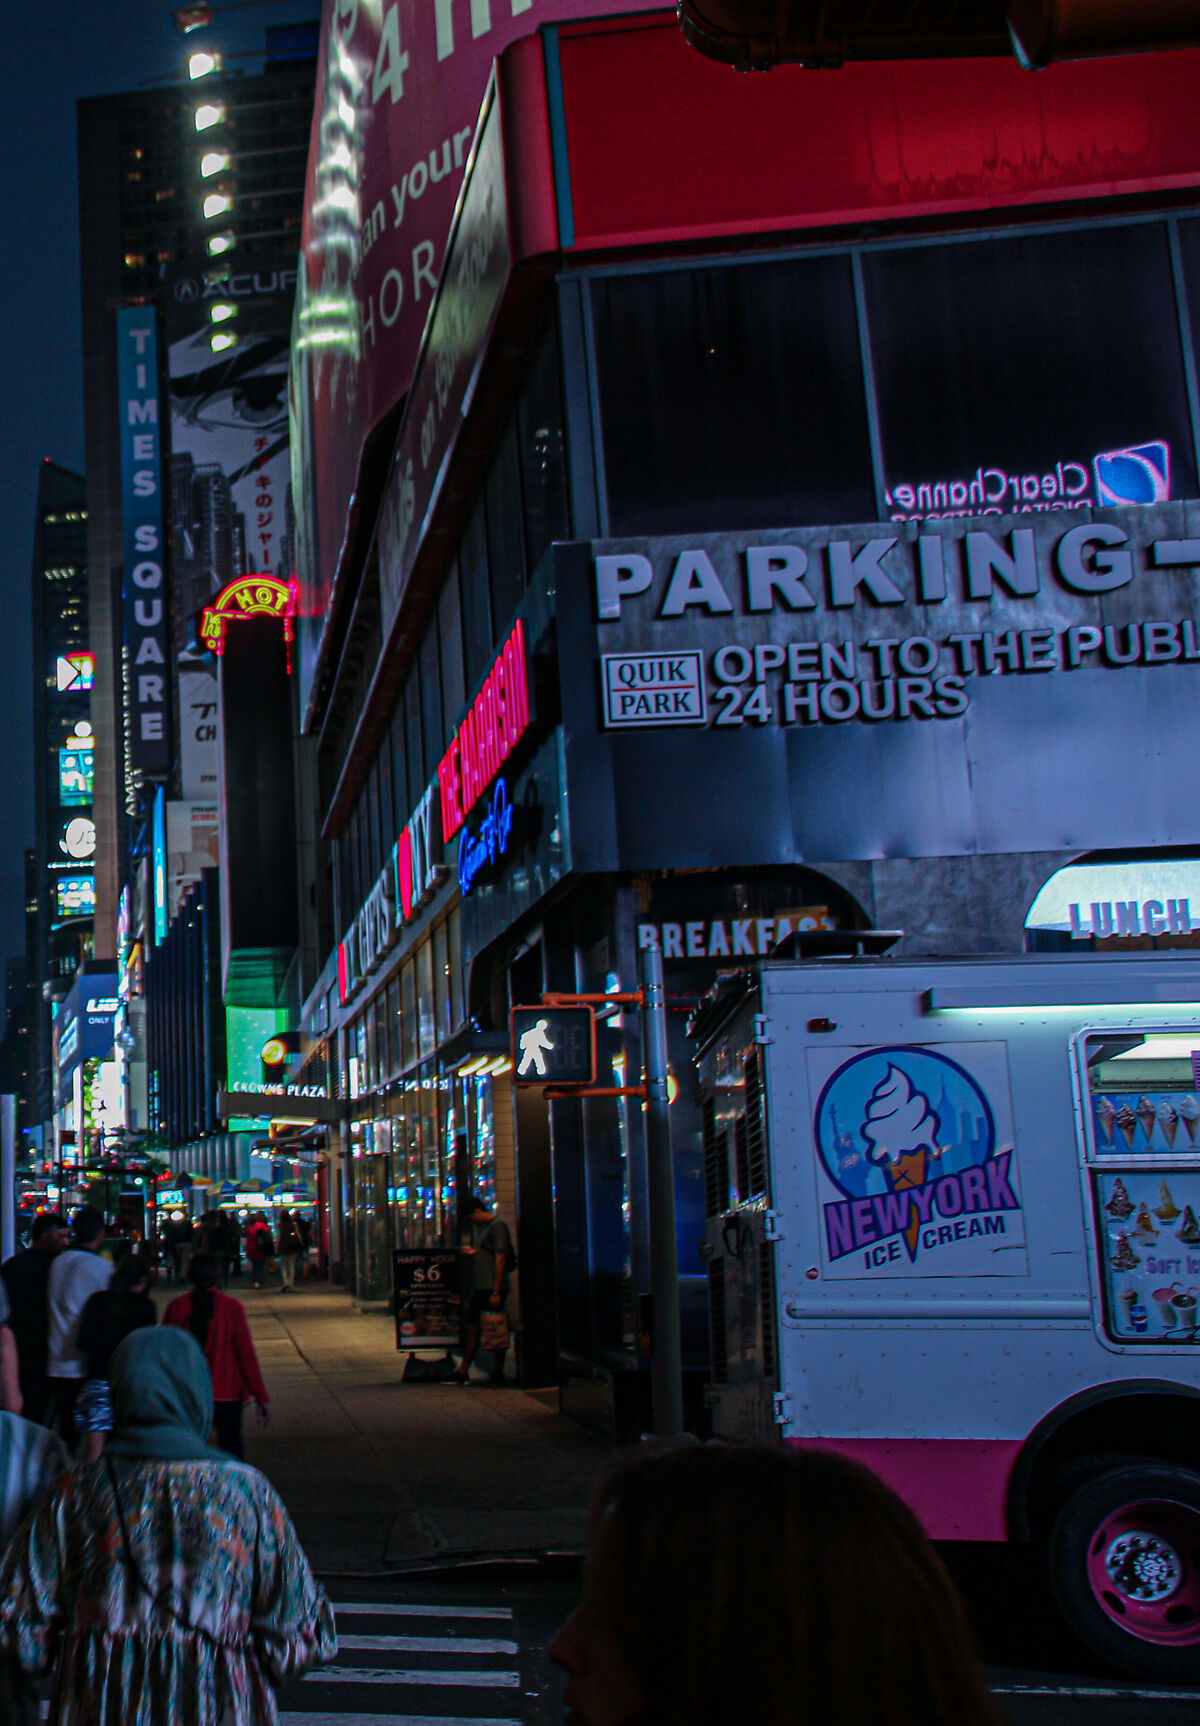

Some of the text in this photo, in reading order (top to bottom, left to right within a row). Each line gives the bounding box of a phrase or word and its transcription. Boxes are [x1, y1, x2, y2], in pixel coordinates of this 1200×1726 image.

[391, 125, 471, 229] your
[127, 327, 158, 497] TIMES
[595, 524, 1134, 619] PARKING
[235, 588, 288, 611] HOT
[132, 524, 165, 741] SQUARE
[713, 619, 1200, 684] OPEN TO THE PUBL
[617, 660, 687, 683] QUIK
[619, 692, 692, 716] PARK
[715, 674, 969, 725] 24 HOURS
[1068, 898, 1191, 940] LUNCH
[233, 1081, 327, 1098] CROWNE PLAZA
[824, 1152, 1022, 1260] NEW YORK
[863, 1214, 1006, 1270] ICE CREAM
[413, 1263, 442, 1283] $6
